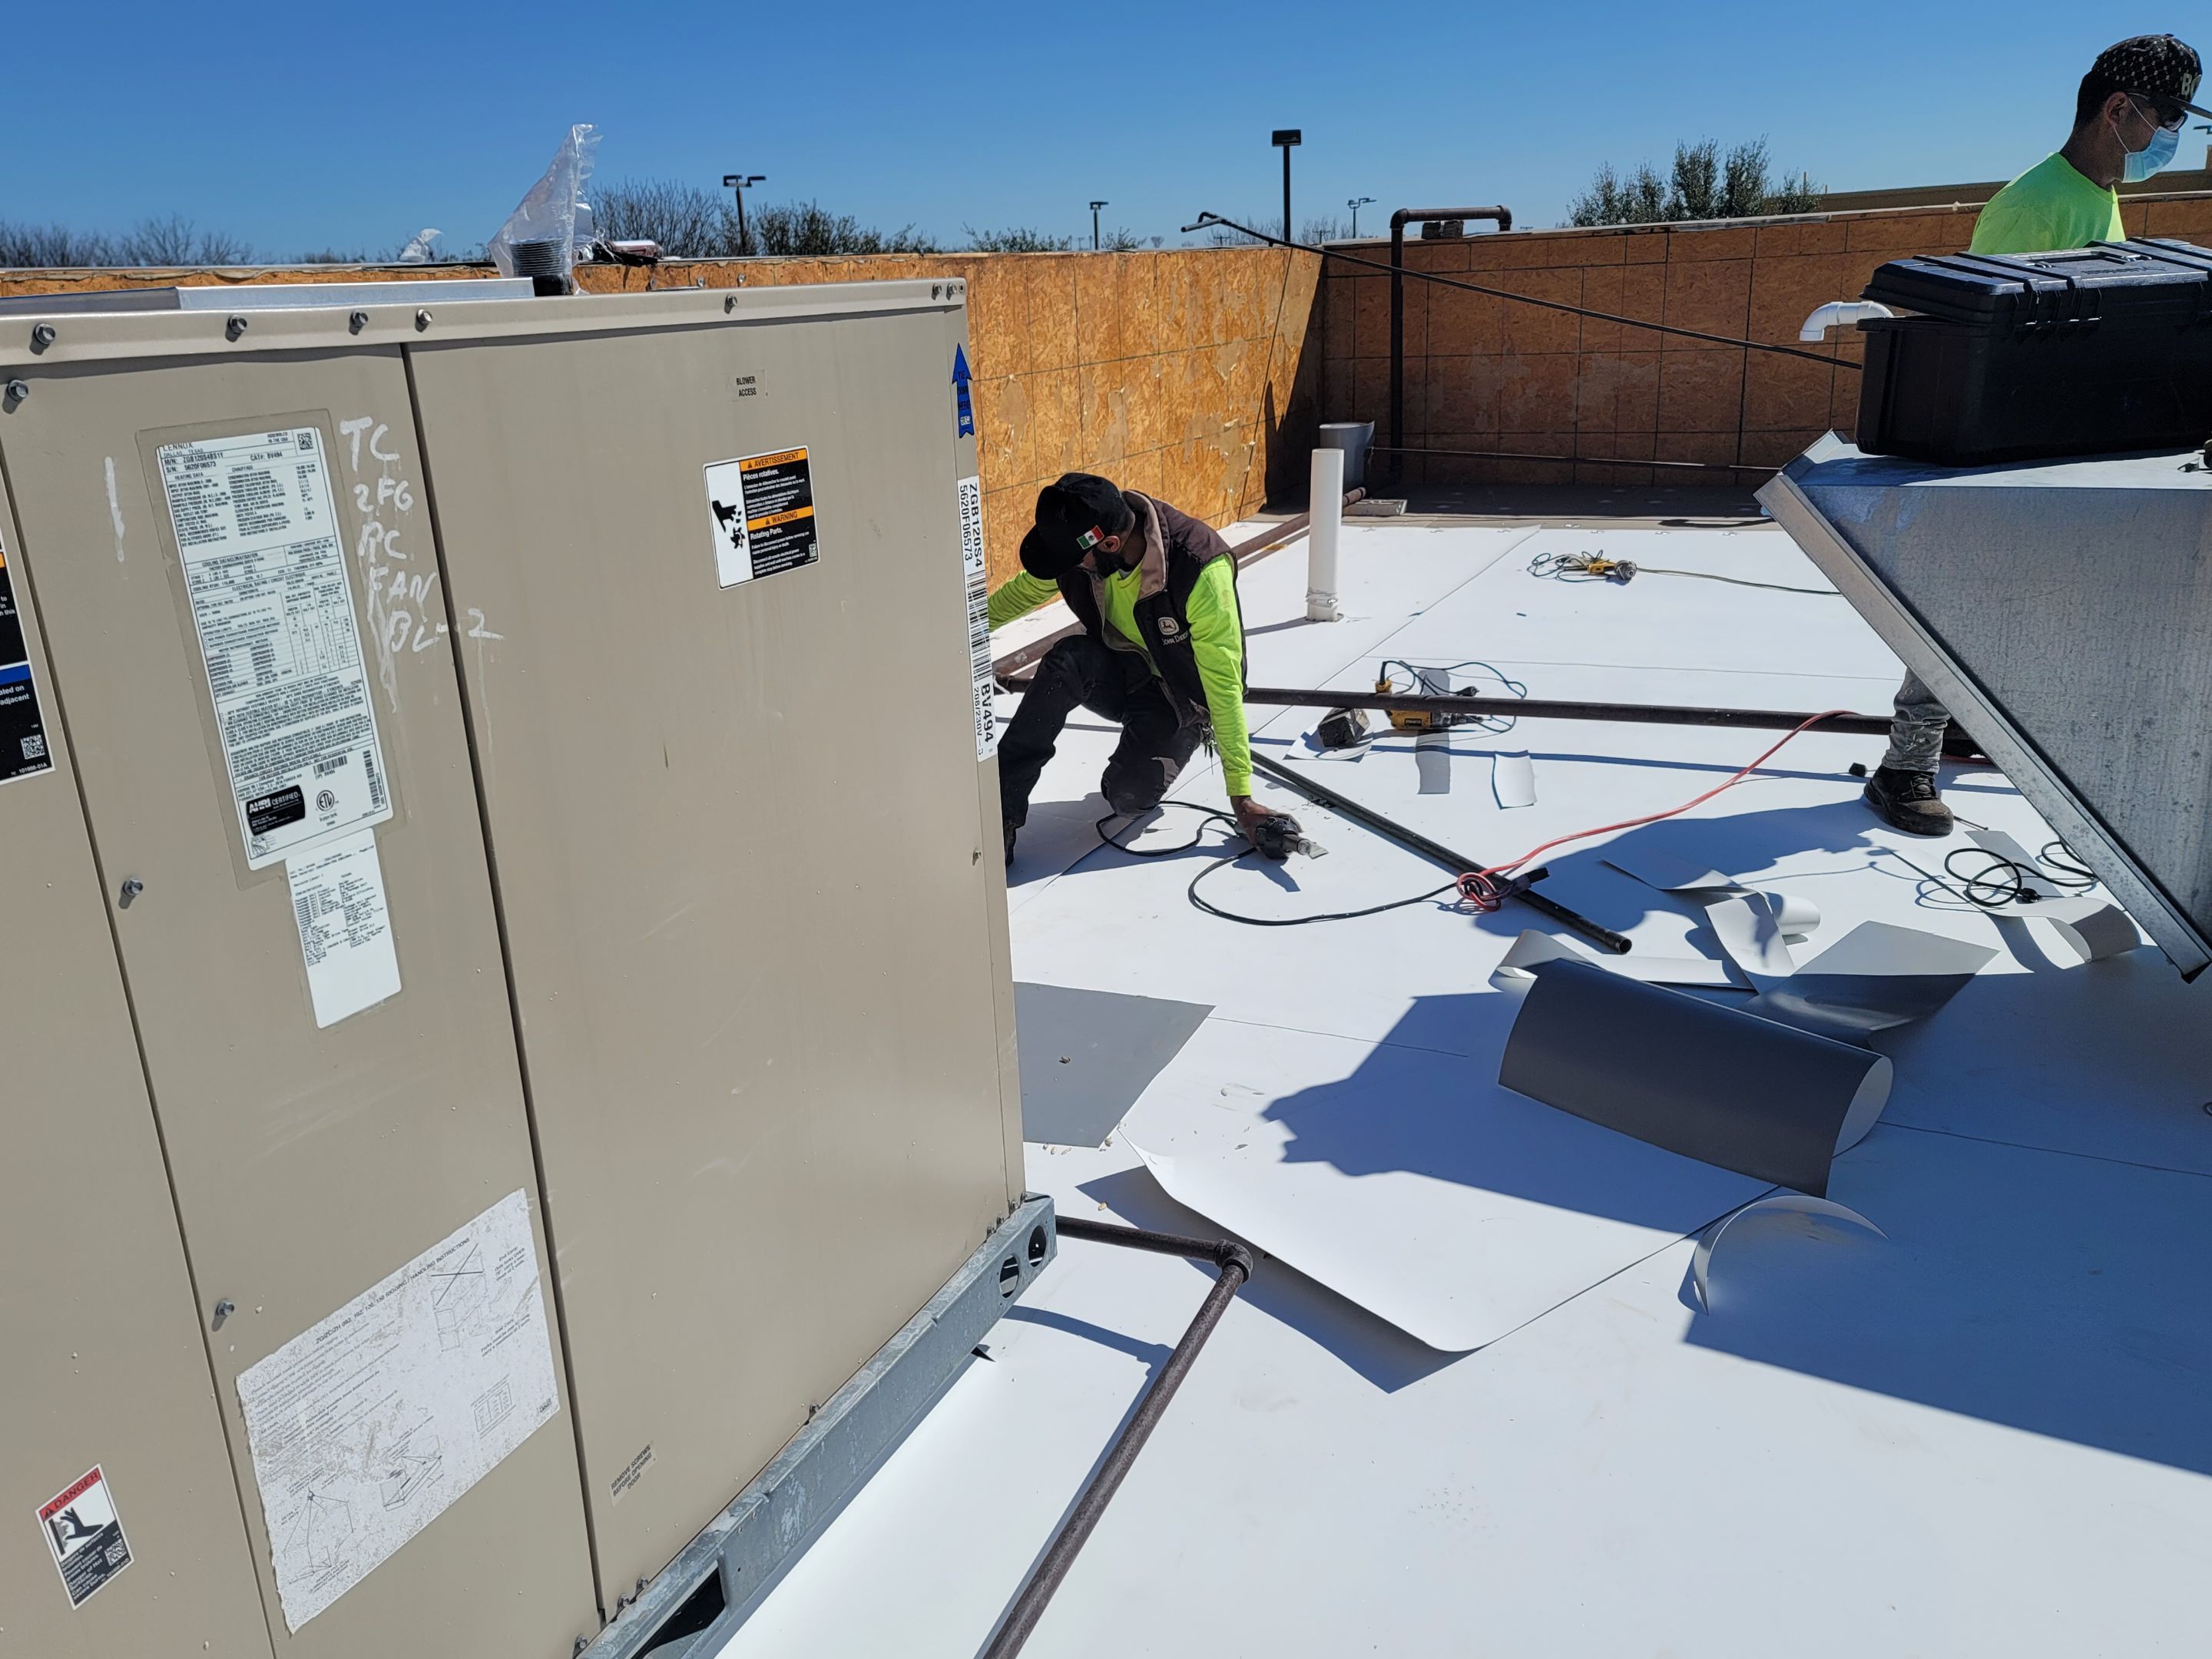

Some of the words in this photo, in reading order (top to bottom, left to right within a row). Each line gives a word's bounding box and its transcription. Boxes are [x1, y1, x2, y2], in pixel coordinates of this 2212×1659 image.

[737, 376, 756, 385] BLOWER
[739, 387, 757, 397] ACCESS
[161, 441, 194, 452] LENNOX
[753, 452, 799, 468] AVERTISSEMENT
[771, 511, 797, 524] WARNING
[959, 485, 972, 561] 5620F06573
[969, 482, 982, 568] ZGB120S4
[750, 529, 770, 541] Rotating
[770, 525, 783, 536] Parts.
[370, 566, 437, 605] FAN
[0, 693, 30, 705] adjacent
[981, 684, 994, 743] BV494
[611, 1465, 631, 1489] REMOVE
[631, 1445, 651, 1468] SCREWS
[613, 1474, 631, 1496] BEFORE
[631, 1452, 651, 1475] OPENING
[628, 1472, 641, 1489] DOOR
[54, 1471, 98, 1508] DANGER
